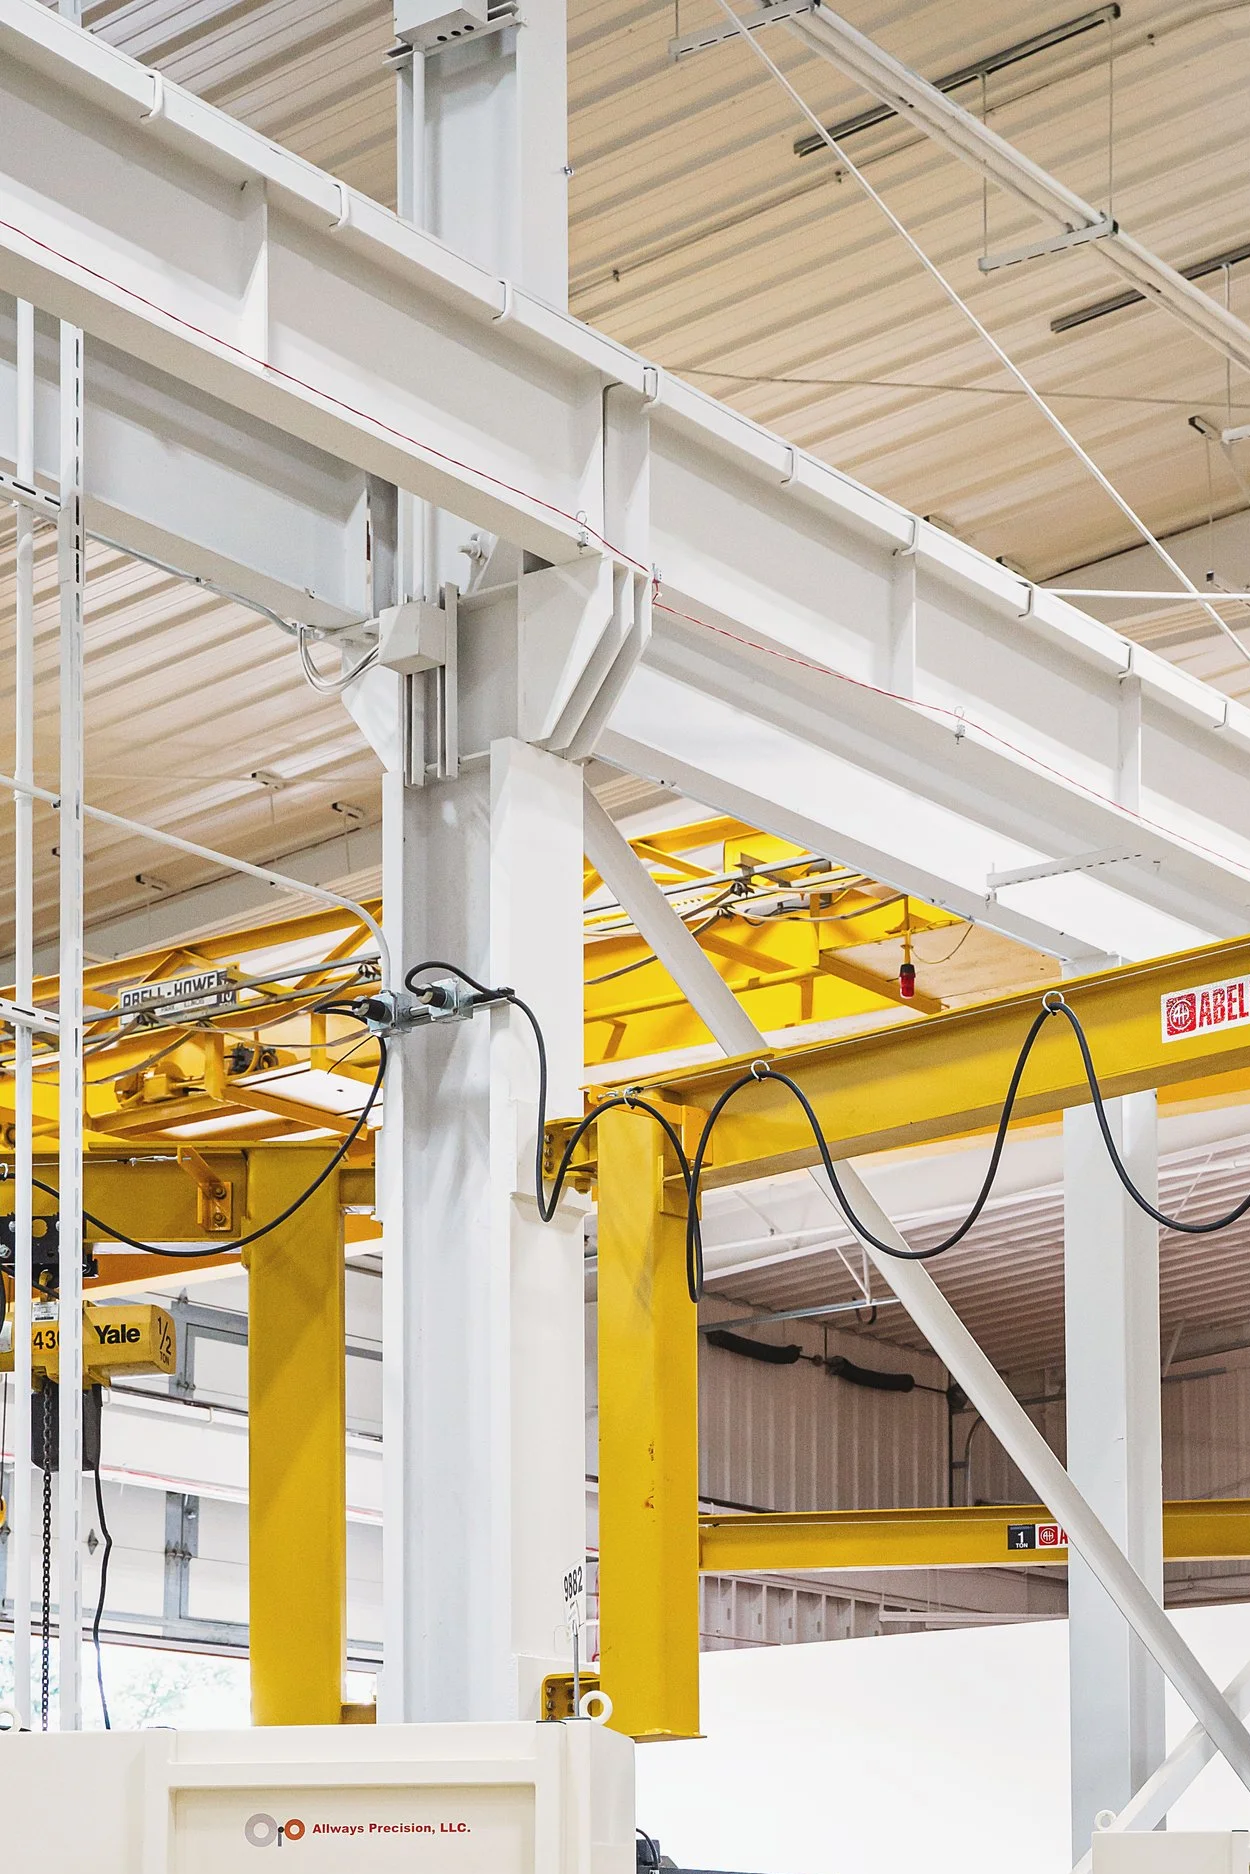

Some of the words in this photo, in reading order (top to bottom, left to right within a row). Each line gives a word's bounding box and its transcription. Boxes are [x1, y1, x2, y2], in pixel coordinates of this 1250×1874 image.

[33, 1331, 59, 1350] 43
[94, 1324, 141, 1345] Yale
[157, 1316, 172, 1355] 1/2
[160, 1351, 170, 1366] TON
[1017, 1531, 1024, 1544] 1
[563, 1566, 583, 1602] 9882
[312, 1823, 365, 1836] Allways
[369, 1823, 436, 1835] Precision,
[440, 1823, 472, 1833] LLC.
